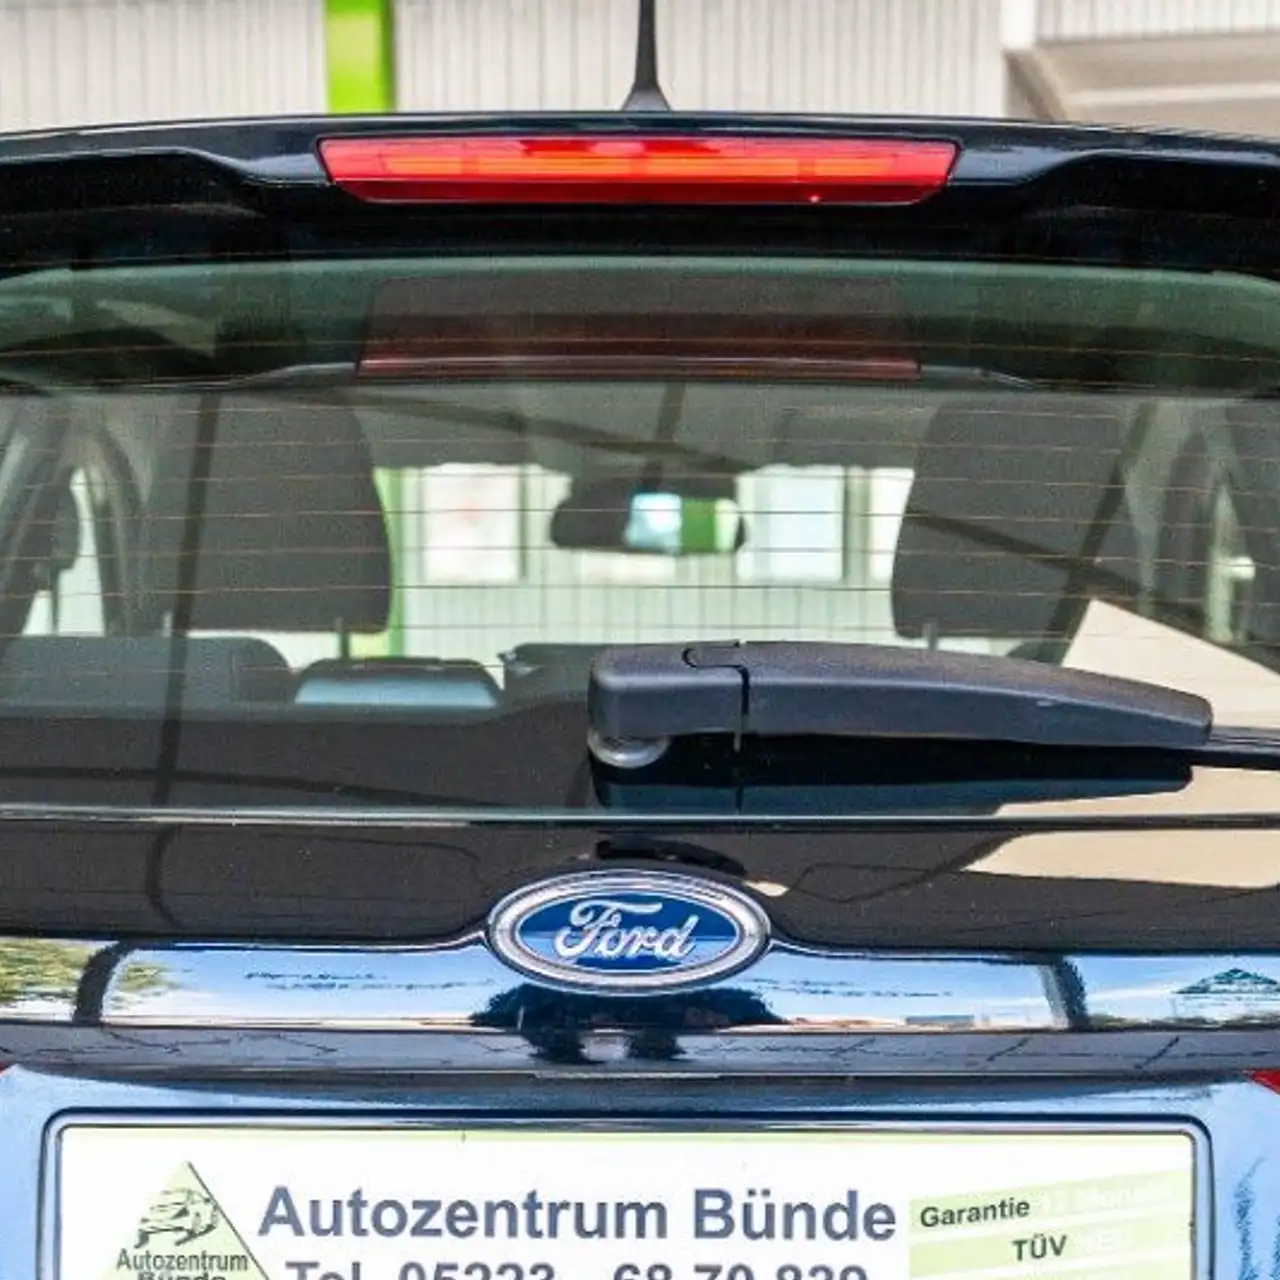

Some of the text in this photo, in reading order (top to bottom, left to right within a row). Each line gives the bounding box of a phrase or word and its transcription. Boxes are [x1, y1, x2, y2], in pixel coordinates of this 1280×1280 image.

[554, 900, 699, 959] Ford
[258, 1185, 897, 1241] Autozentrum Bünde
[919, 1198, 1031, 1228] Garantie
[116, 1248, 249, 1271] Autozentrum
[1011, 1234, 1068, 1262] TÜV
